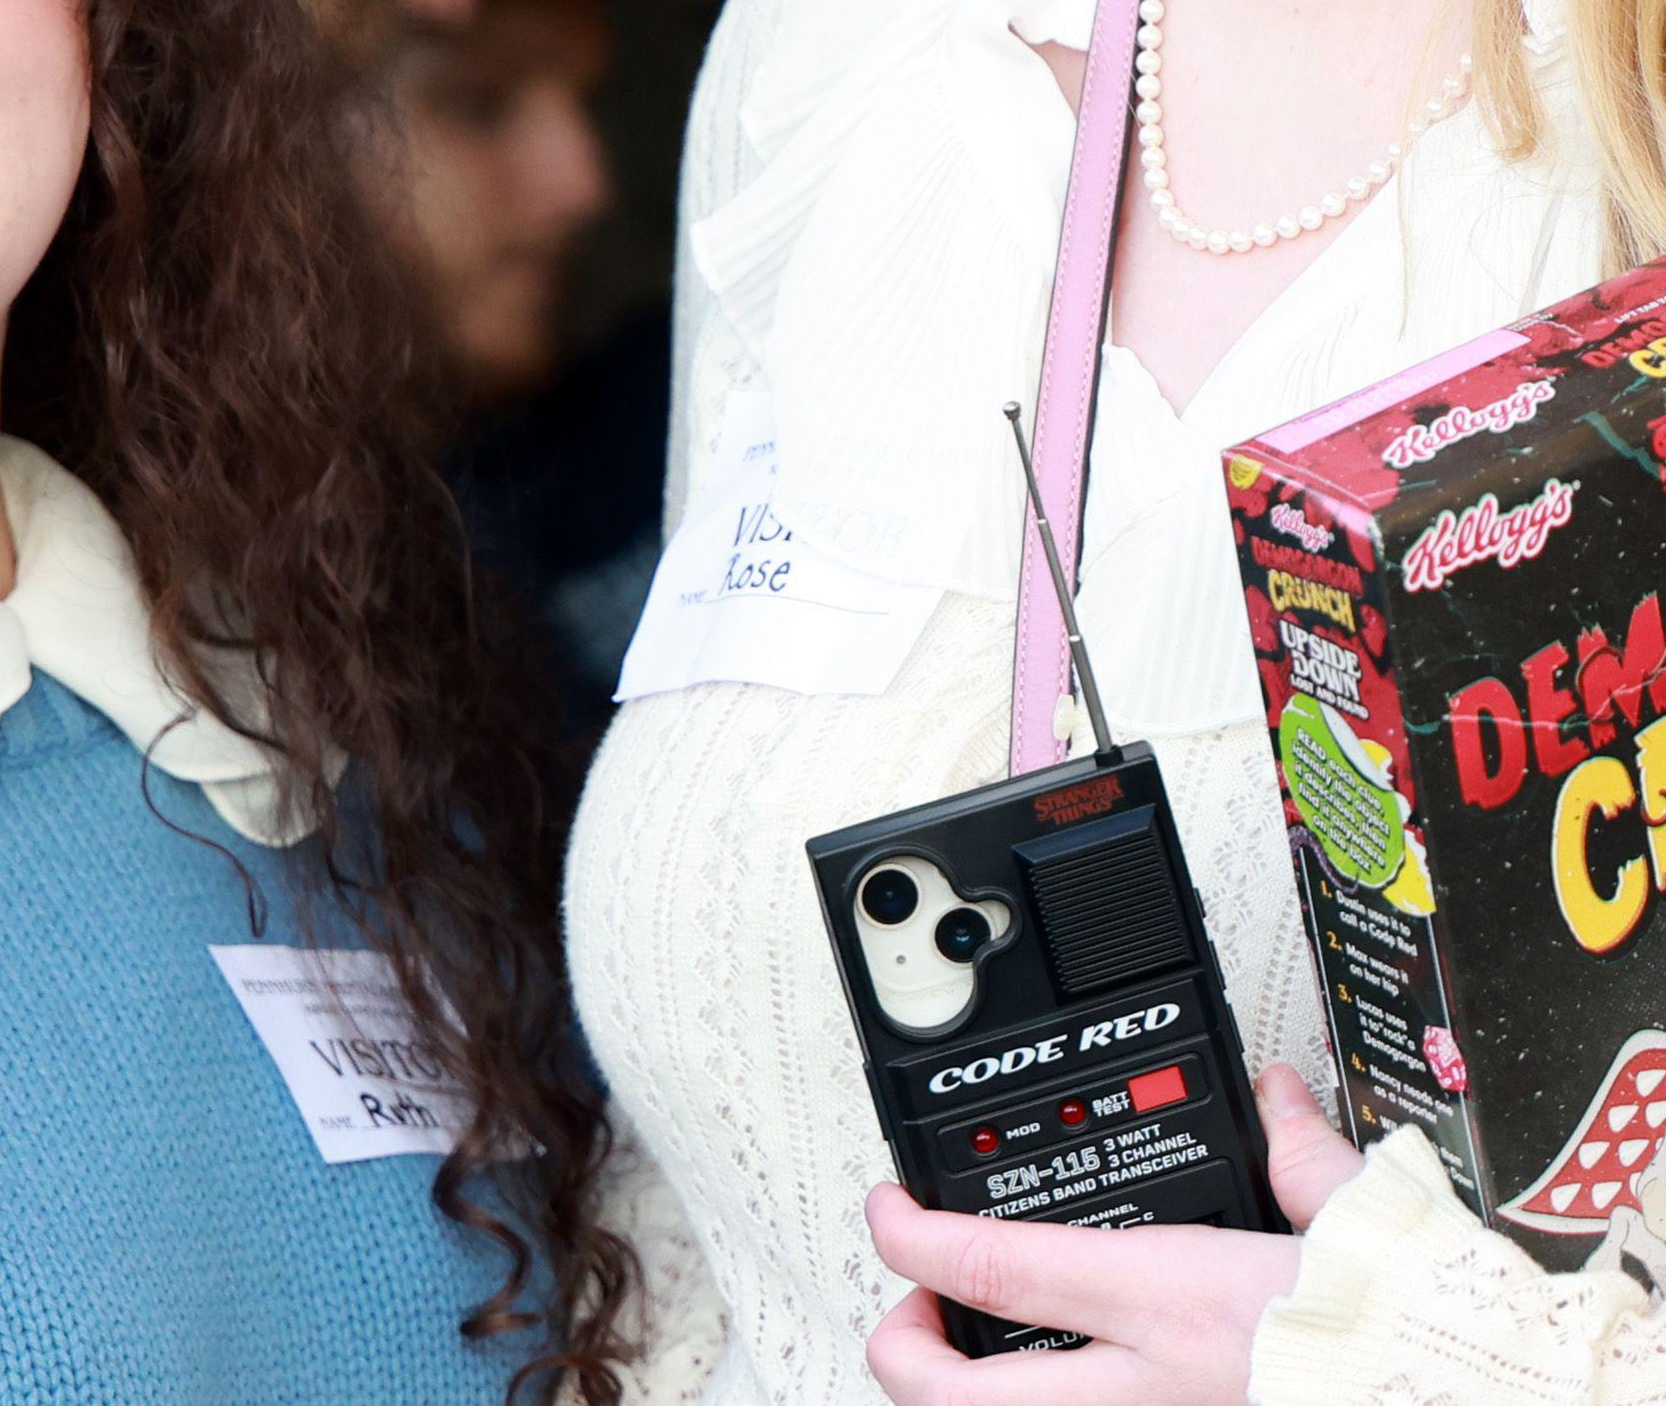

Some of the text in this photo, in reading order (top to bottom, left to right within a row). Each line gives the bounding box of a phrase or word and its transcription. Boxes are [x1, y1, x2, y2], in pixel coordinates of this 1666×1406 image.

[1381, 381, 1555, 468] Kellogg's
[1403, 480, 1573, 591] Kellogg's
[1267, 569, 1357, 633] CRUNCH
[1280, 619, 1362, 679] UPSIDE
[1290, 673, 1314, 694] LOST
[1291, 650, 1361, 702] DOWN
[1297, 728, 1327, 761] READ
[1033, 773, 1125, 822] STRANGER
[1052, 797, 1114, 826] THINGS
[1292, 740, 1391, 837] identify the object
[1298, 782, 1321, 809] find
[1331, 813, 1386, 870] anywhere
[1312, 814, 1373, 875] on the box
[1361, 820, 1387, 850] then
[1336, 889, 1367, 915] Dustin
[1367, 908, 1390, 928] uses
[1399, 921, 1412, 937] to
[1339, 911, 1358, 928] call
[1396, 936, 1419, 957] Red
[1326, 930, 1343, 952] 2.
[1345, 942, 1369, 965] Max
[1369, 955, 1400, 980] wears
[1349, 963, 1400, 997] on her hip
[1337, 983, 1409, 1032] 3. Lucas uses
[929, 1002, 1181, 1094] CODE RED
[1362, 1030, 1427, 1073] Demogorgon
[1092, 1091, 1129, 1109] BATT
[1351, 1052, 1455, 1118] 4. Nancy needs one
[1374, 1085, 1387, 1099] as
[1398, 1096, 1438, 1125] reporter
[359, 1091, 440, 1129] Ruth
[1006, 1122, 1041, 1140] MOD
[1093, 1099, 1131, 1118] TEST
[1361, 1104, 1377, 1125] 5.
[1104, 1123, 1162, 1152] 3 WATT
[1108, 1132, 1198, 1169] 3 CHANNEL
[986, 1146, 1102, 1200] SZN-115
[1053, 1178, 1097, 1202] BAND
[1100, 1144, 1209, 1187] TRANSCEIVER
[1067, 1203, 1140, 1227] CHANNEL
[1143, 1211, 1155, 1222] C
